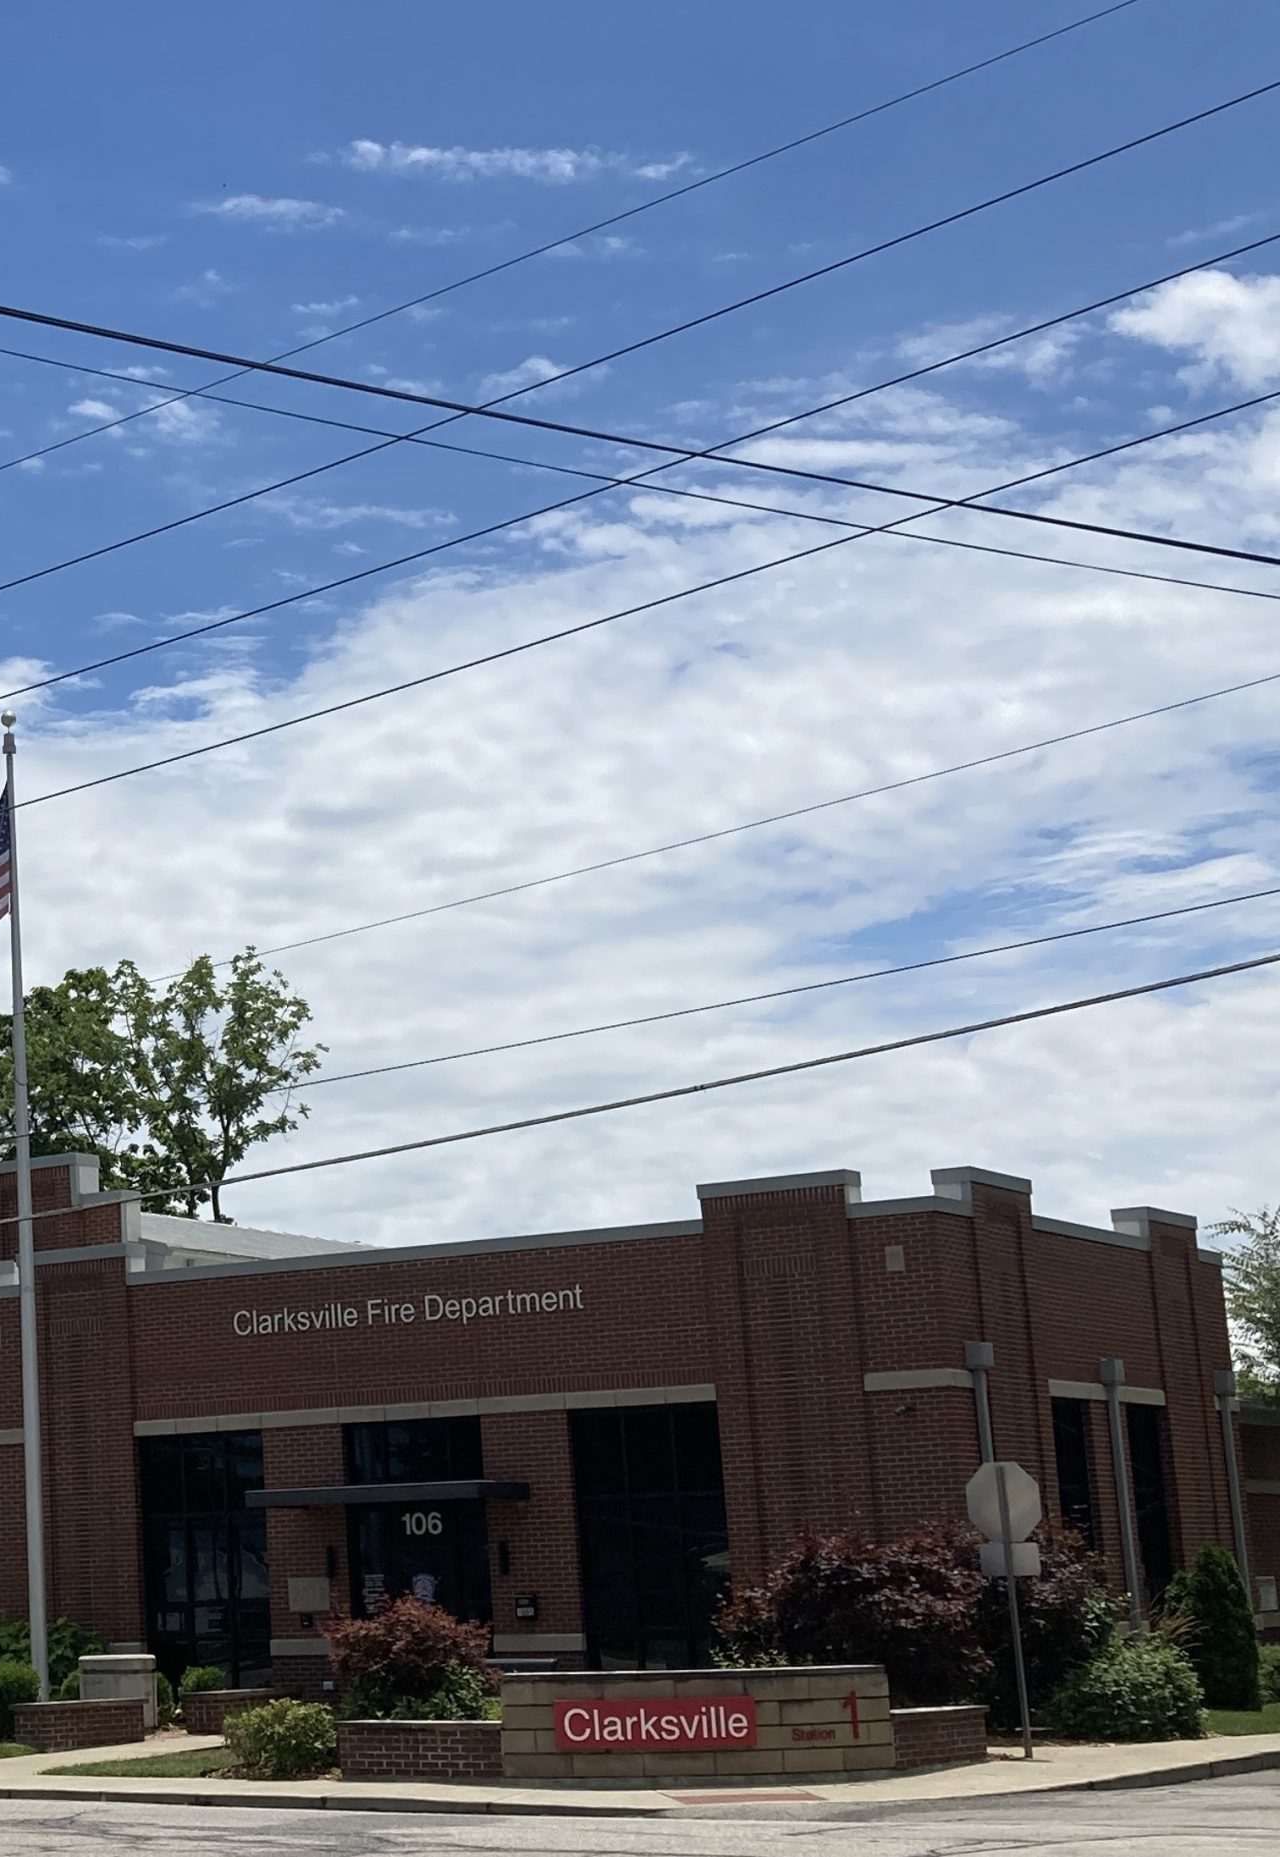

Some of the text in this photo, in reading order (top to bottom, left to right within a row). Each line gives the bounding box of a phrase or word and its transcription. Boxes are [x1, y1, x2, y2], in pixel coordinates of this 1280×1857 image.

[233, 1283, 585, 1336] Clarksville Fire Department
[401, 1512, 444, 1535] 106
[562, 1706, 749, 1743] Clarksville
[791, 1690, 860, 1741] Station 1
